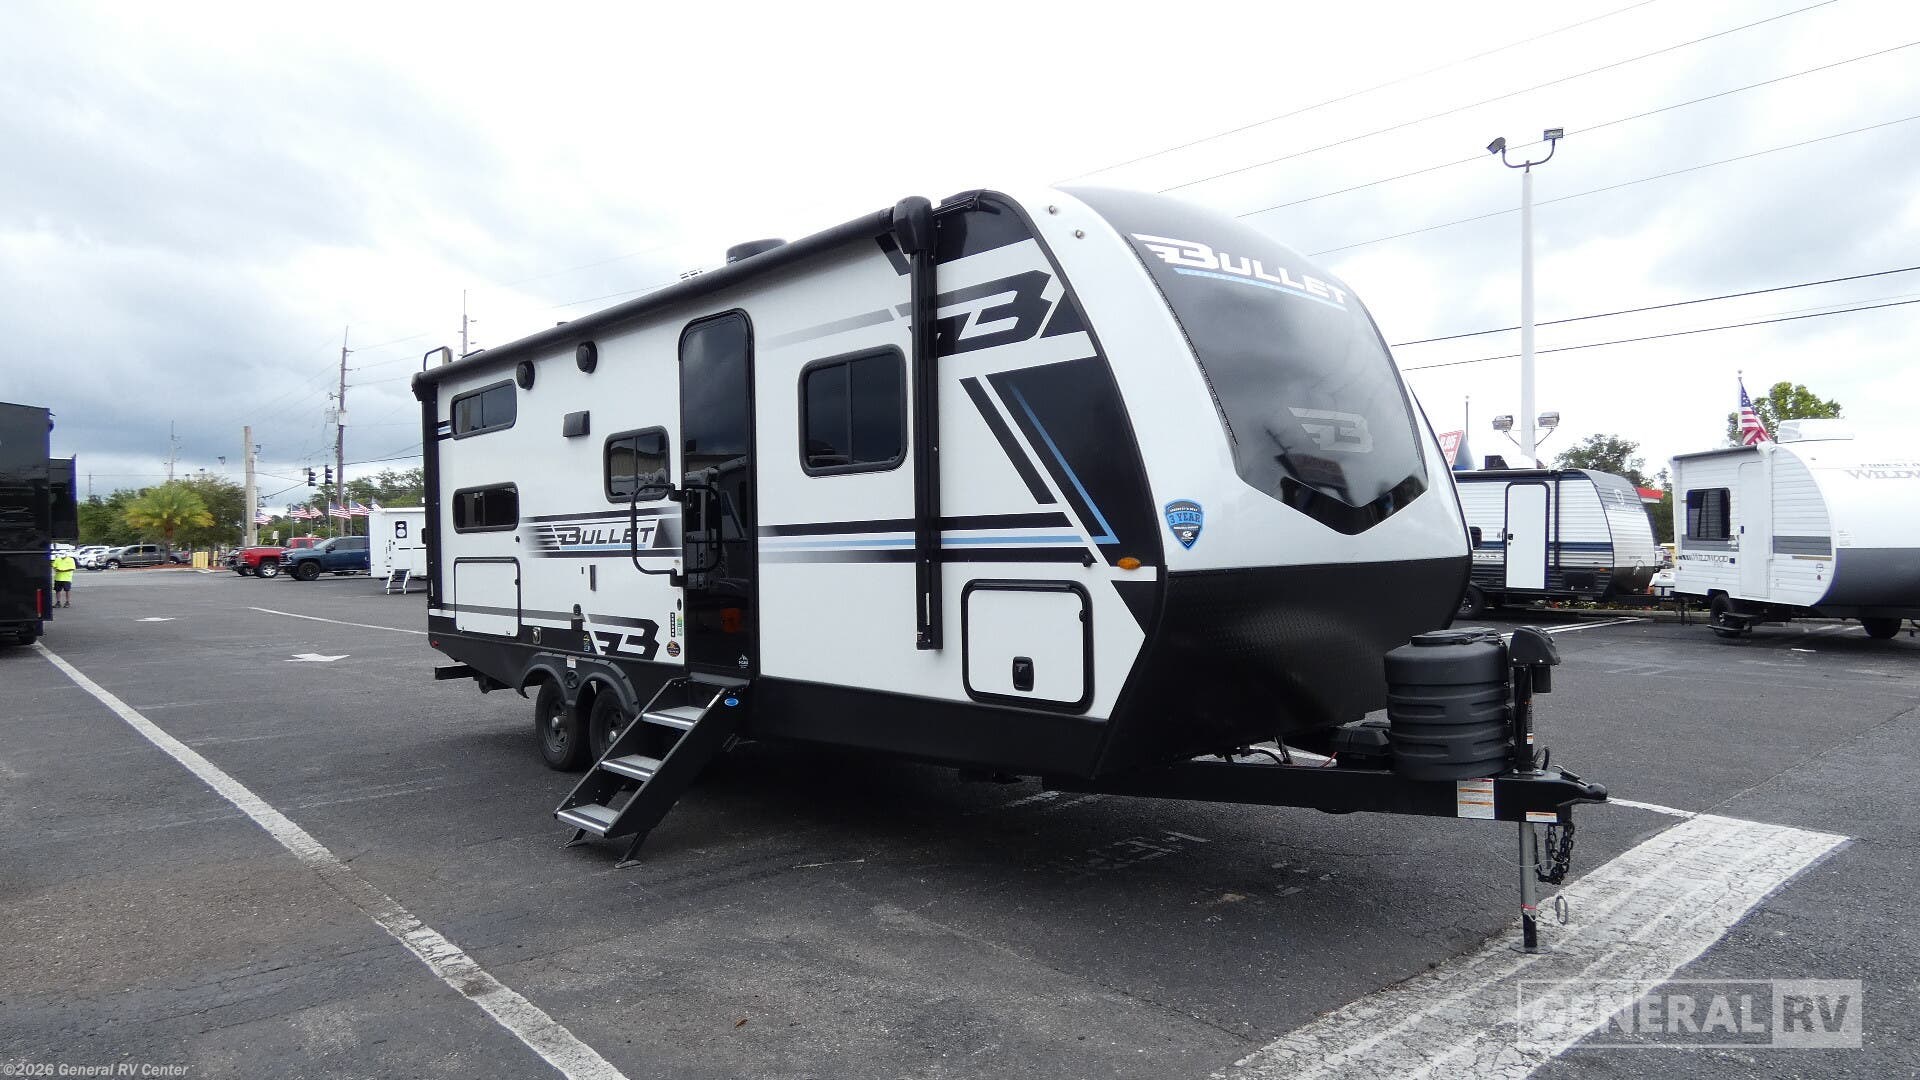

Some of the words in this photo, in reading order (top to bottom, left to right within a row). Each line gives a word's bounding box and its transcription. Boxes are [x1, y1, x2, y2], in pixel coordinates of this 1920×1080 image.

[1131, 233, 1346, 304] BULLET
[1177, 512, 1200, 523] YEAR
[554, 526, 655, 546] BULLET
